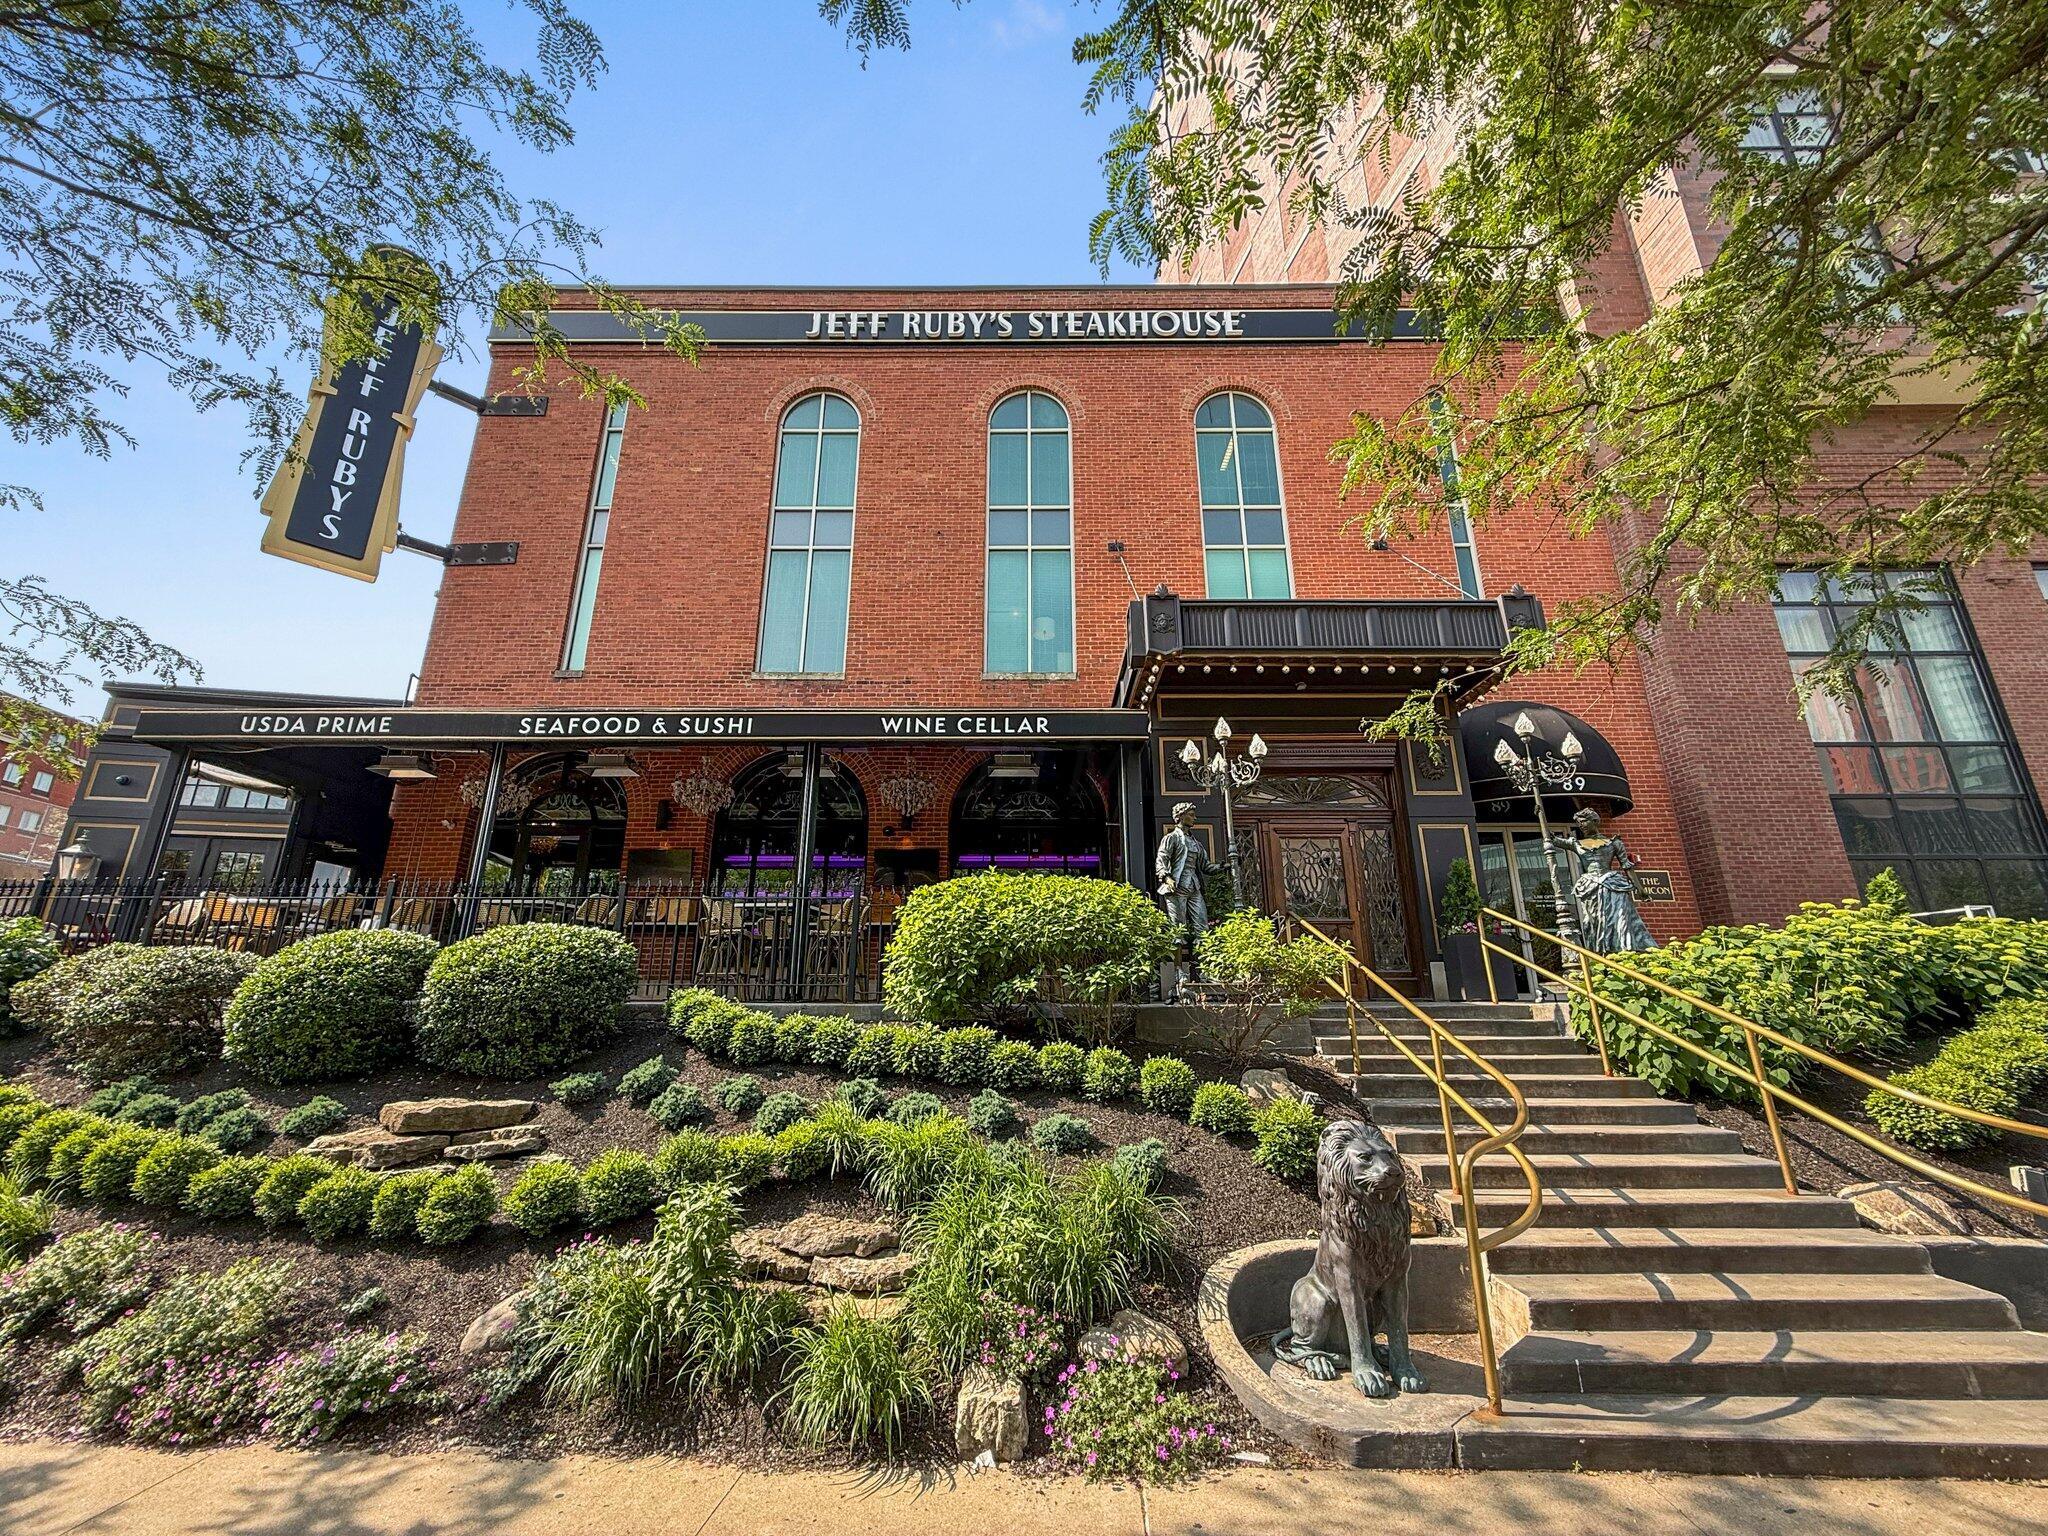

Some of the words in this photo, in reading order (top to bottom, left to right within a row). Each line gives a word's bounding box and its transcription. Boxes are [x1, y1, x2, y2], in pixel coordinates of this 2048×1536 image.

[805, 312, 888, 337] JEFF
[902, 312, 1012, 338] RUBY'S
[1028, 311, 1243, 337] STEAKHOUSE
[240, 716, 305, 733] USDA
[316, 716, 392, 733] PRIME
[518, 717, 641, 734] SEAFOOD
[652, 717, 668, 734] &
[678, 717, 753, 734] SUSHI
[881, 717, 946, 734] WINE
[957, 717, 1050, 734] CELLAR
[1563, 776, 1586, 791] 89
[1640, 877, 1661, 885] THE
